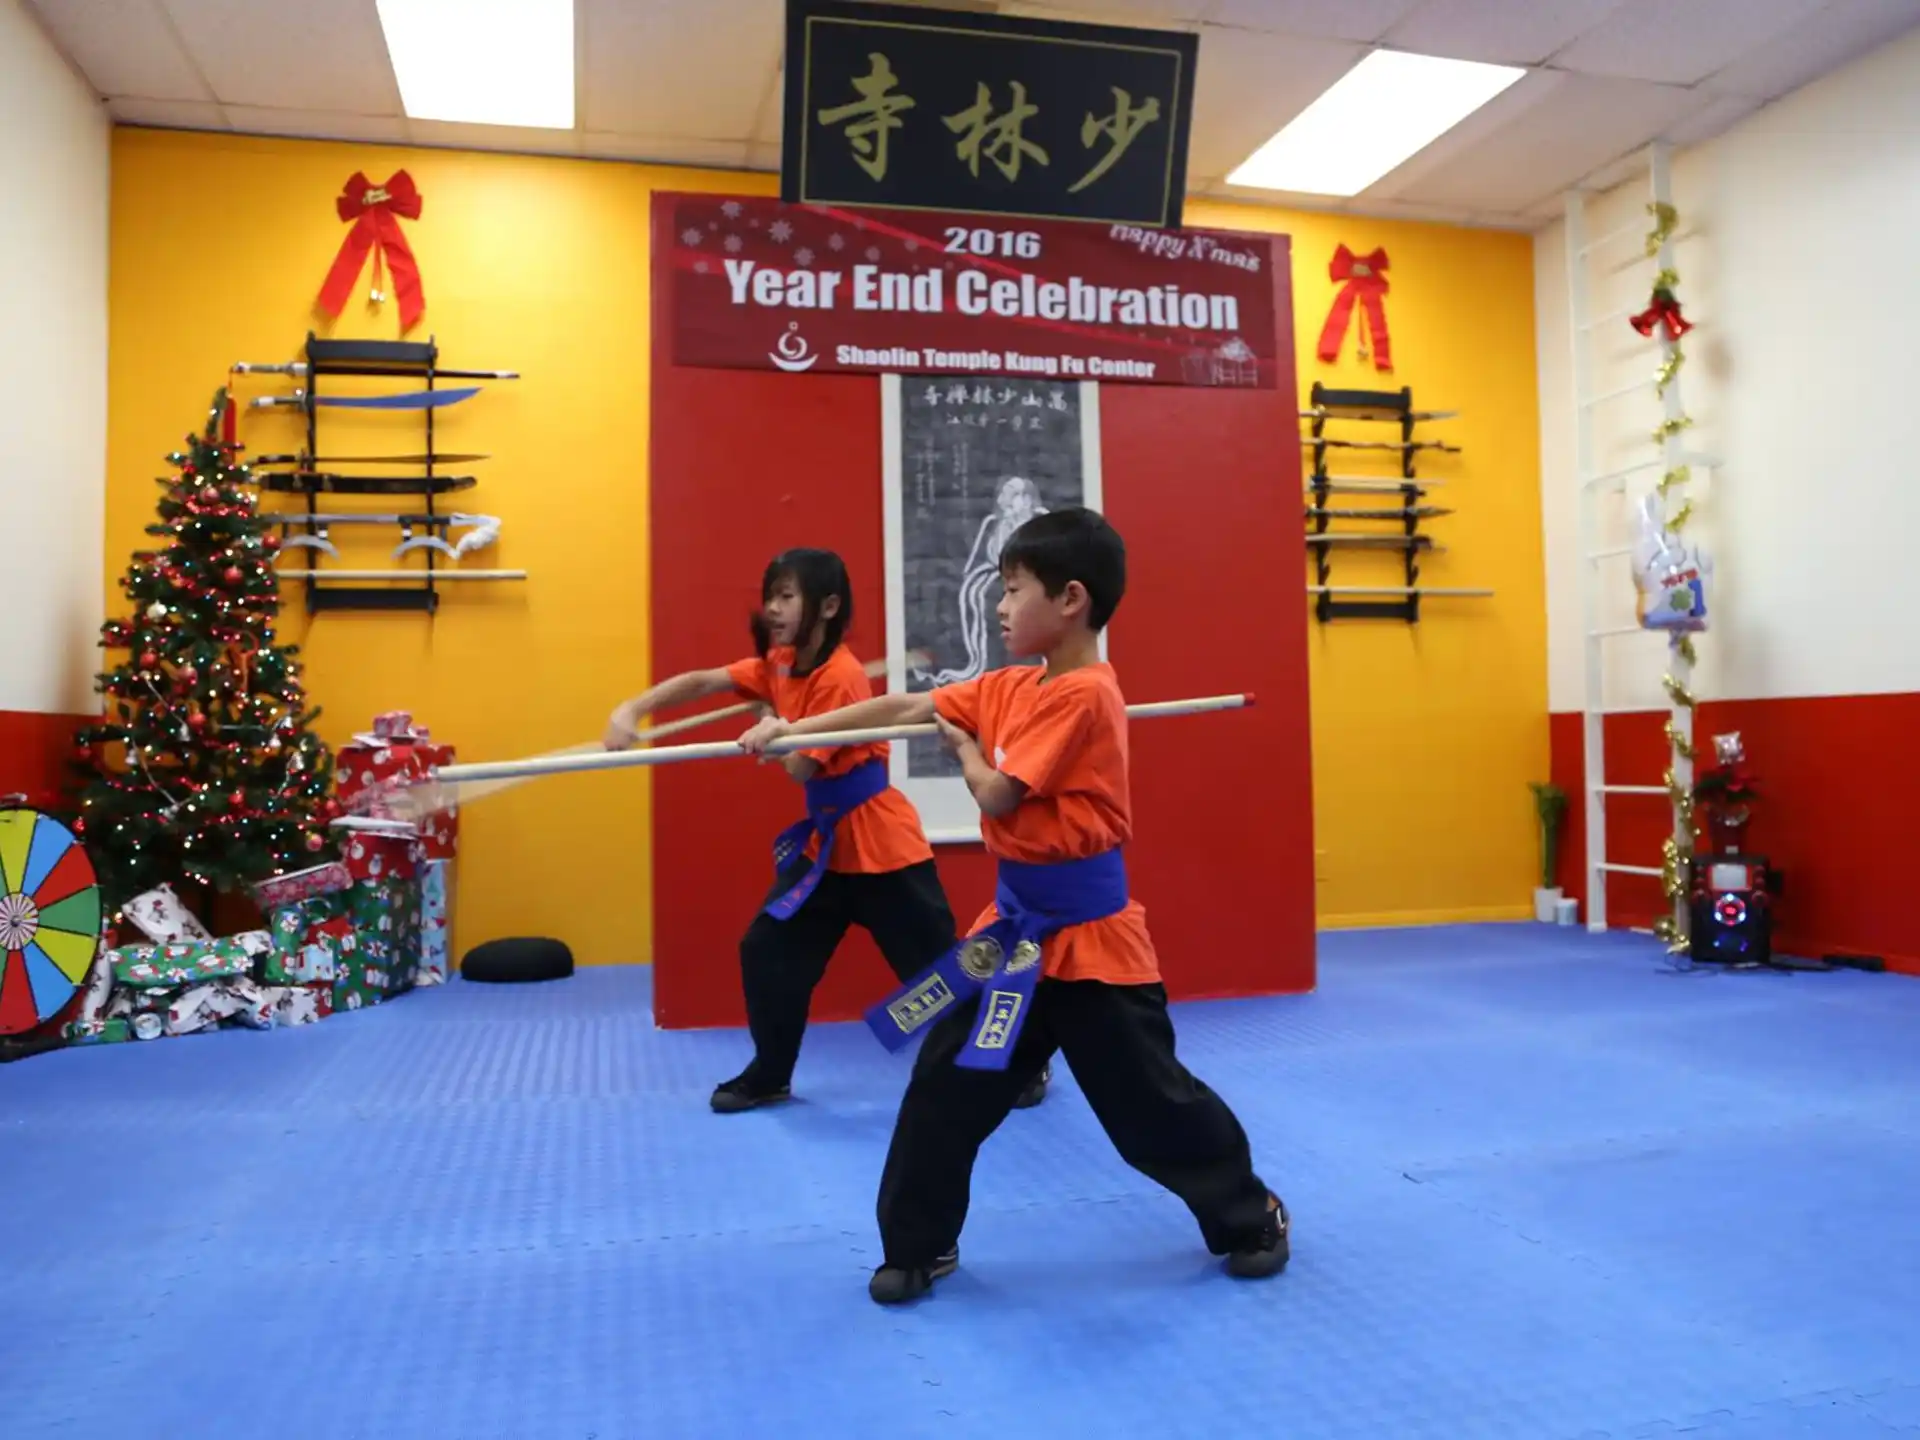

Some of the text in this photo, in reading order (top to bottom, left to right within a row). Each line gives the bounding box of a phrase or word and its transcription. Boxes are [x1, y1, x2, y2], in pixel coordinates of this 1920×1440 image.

[944, 228, 1041, 259] 2016
[1110, 223, 1186, 259] Happy
[723, 259, 1239, 331] Year End Celebration
[836, 344, 1156, 378] Shaolin Temple Kung Fu Center
